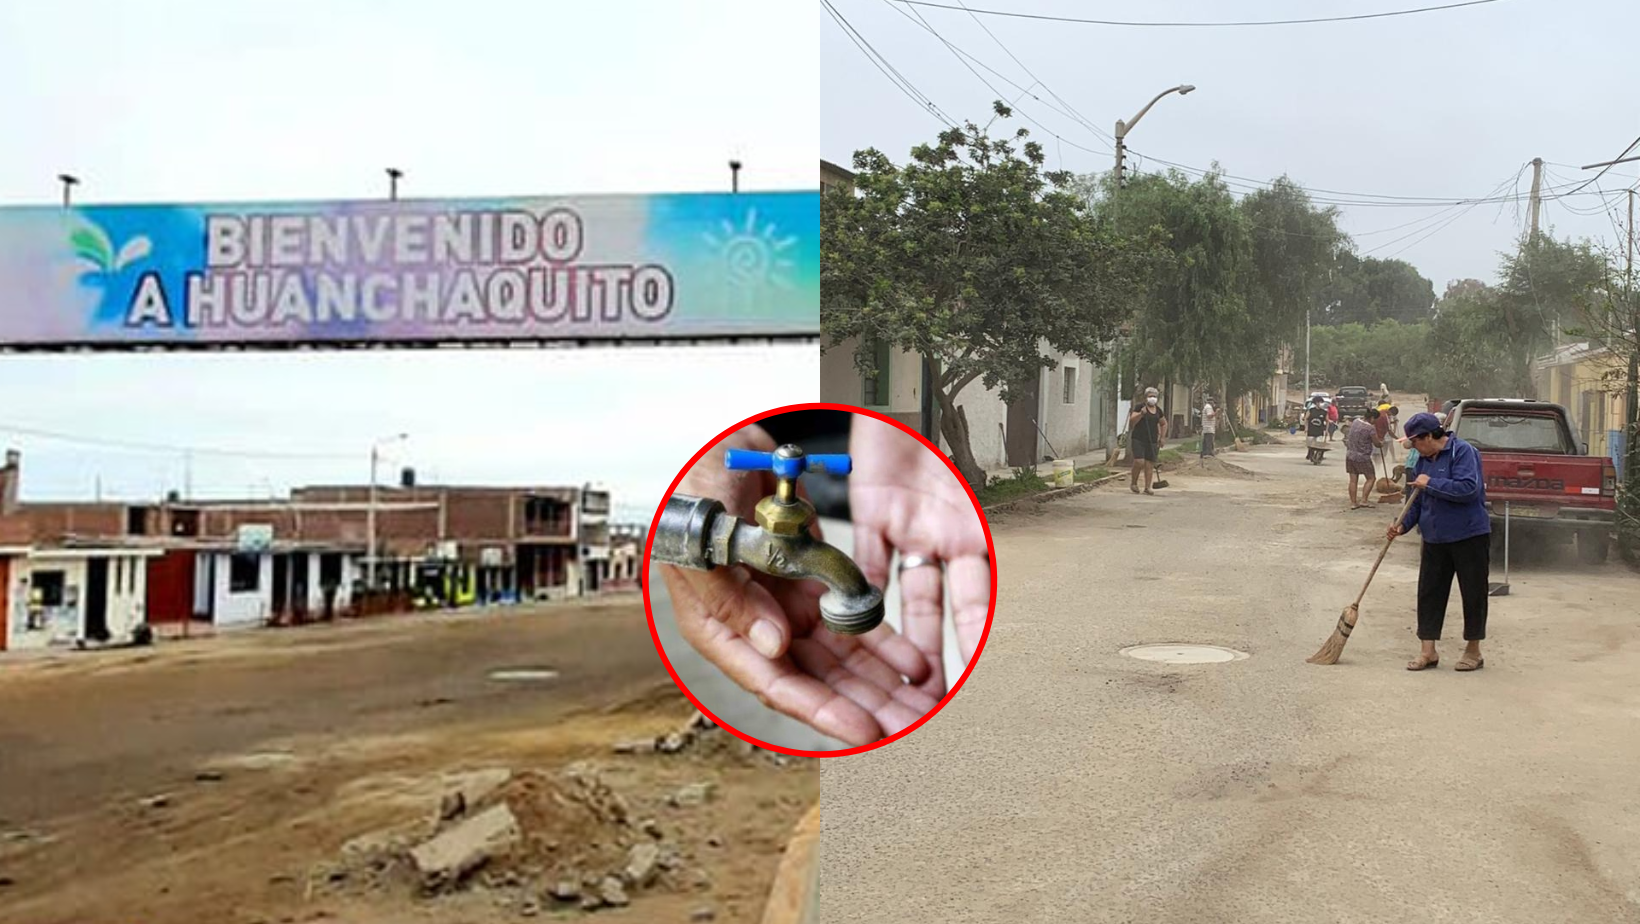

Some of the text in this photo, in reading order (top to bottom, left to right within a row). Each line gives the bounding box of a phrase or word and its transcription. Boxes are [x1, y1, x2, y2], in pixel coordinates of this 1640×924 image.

[206, 208, 581, 267] BIENVENIDO
[125, 264, 674, 328] A HUANCHAQUITO
